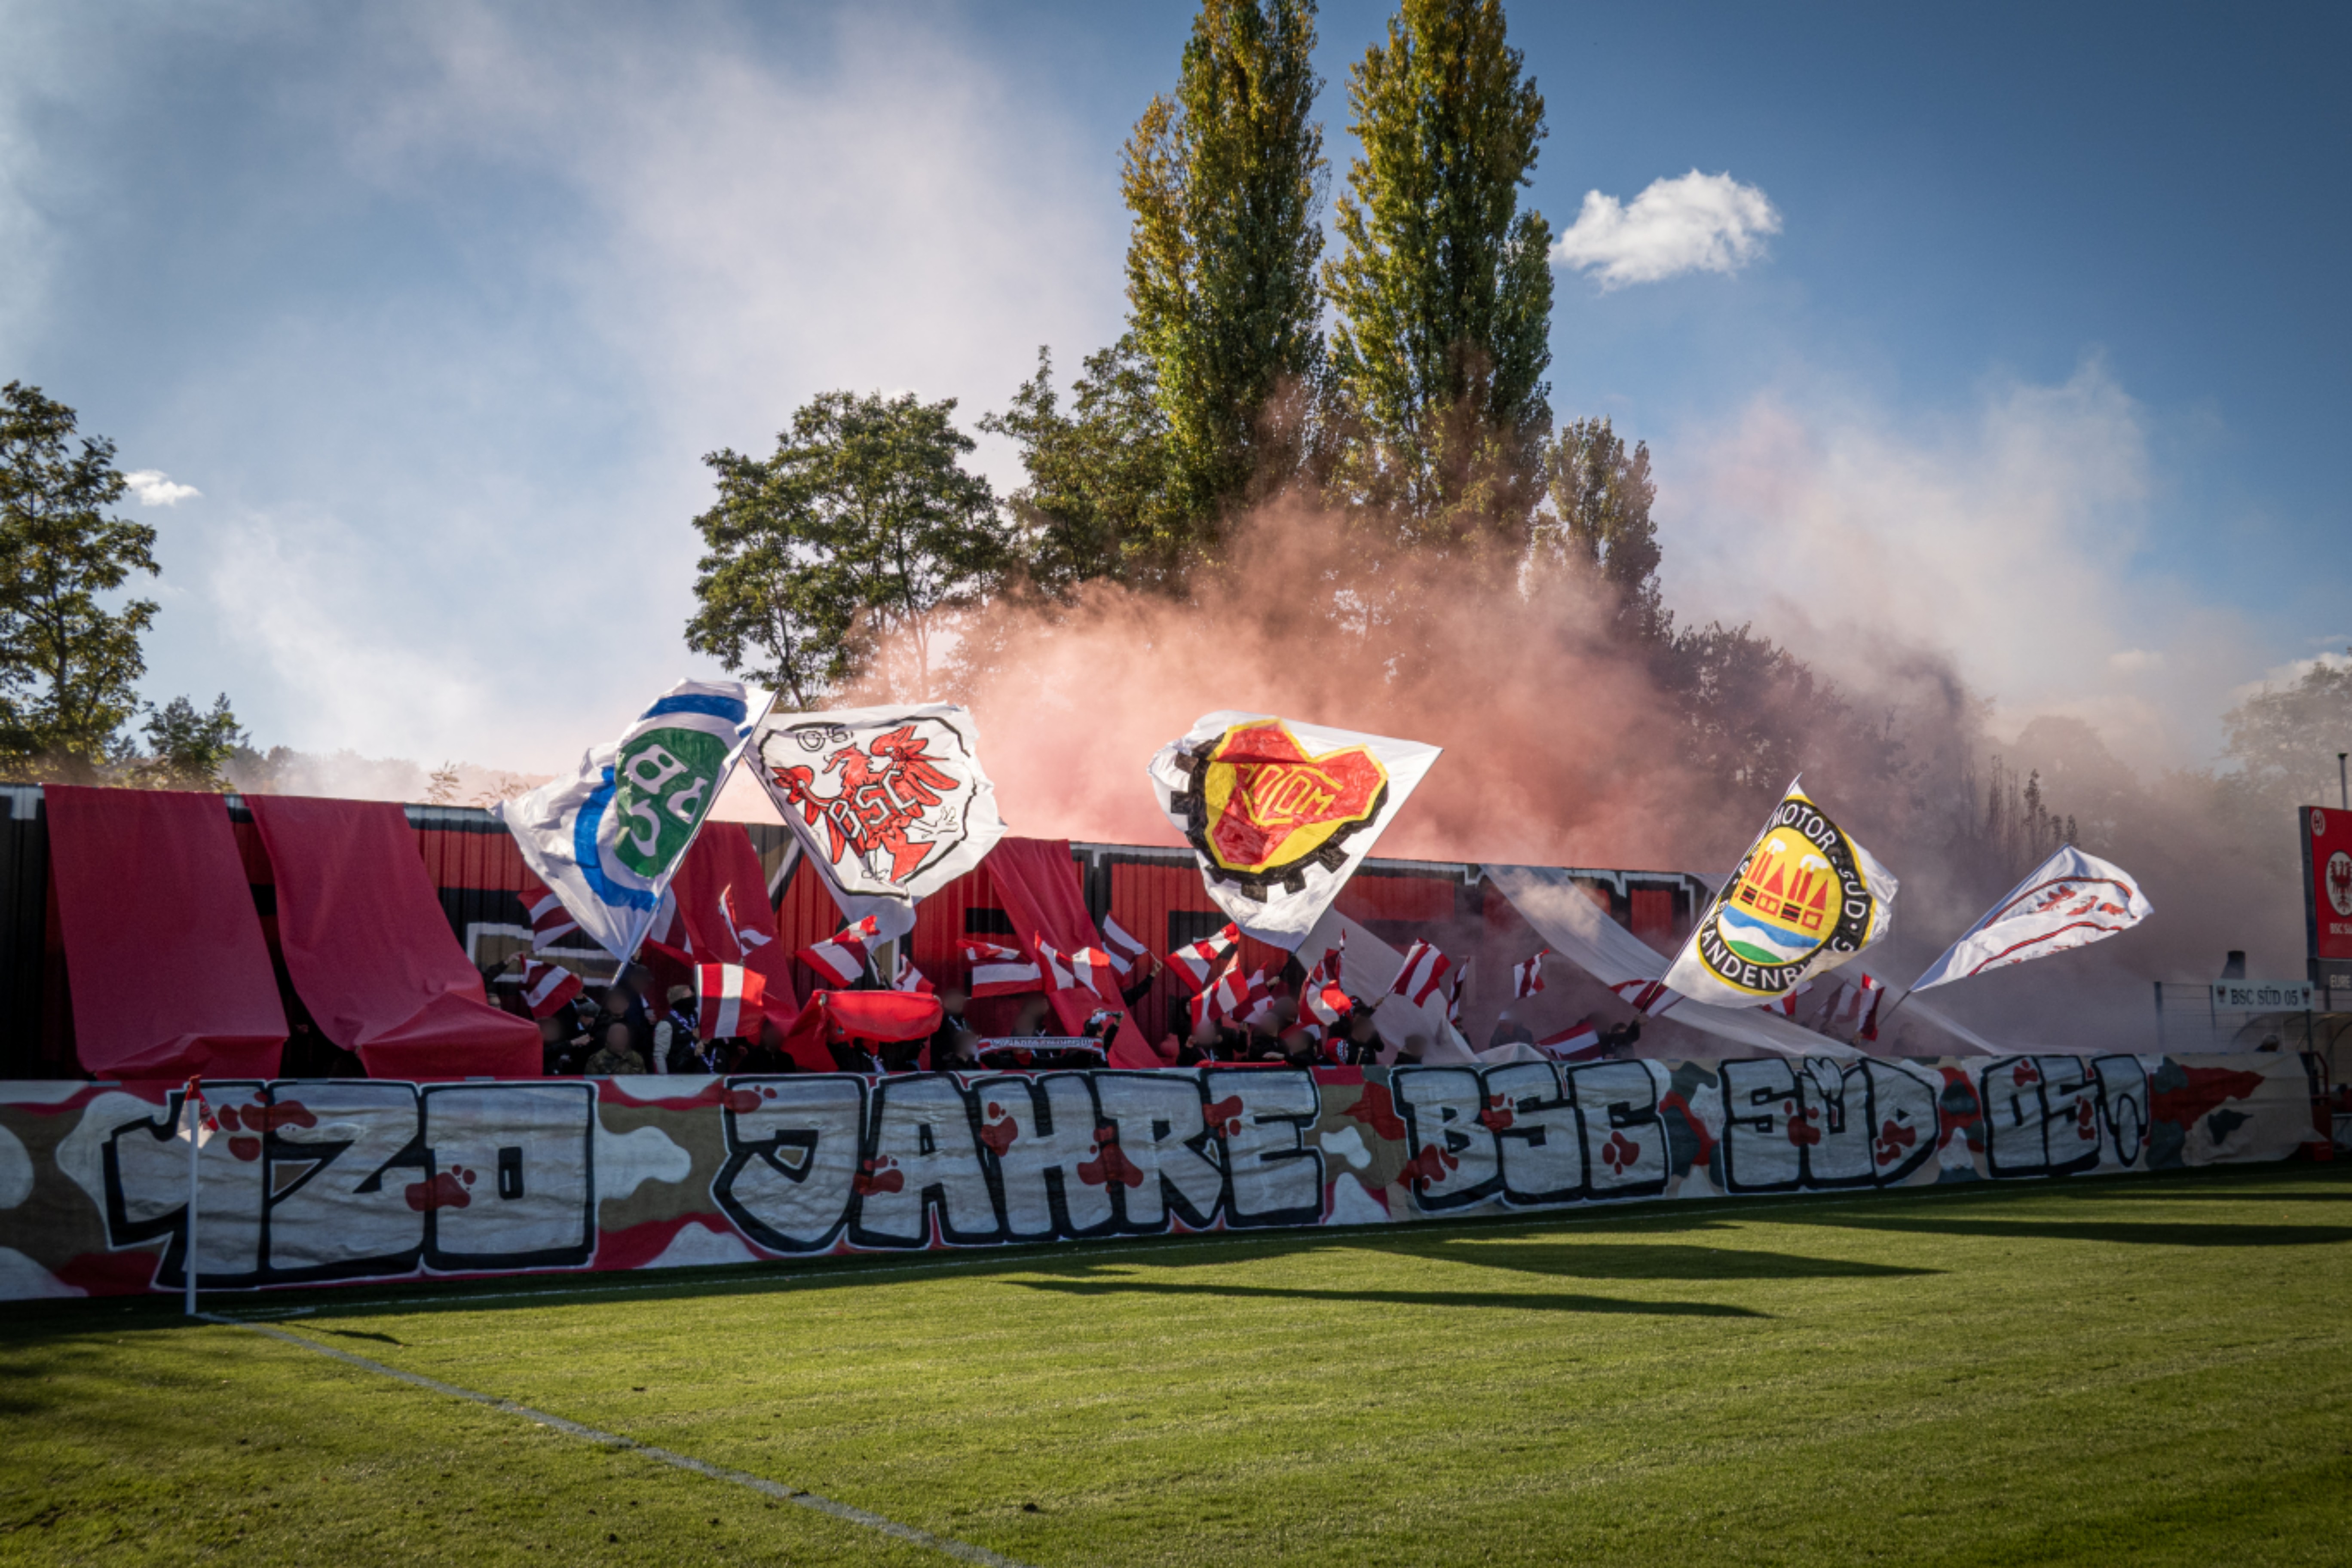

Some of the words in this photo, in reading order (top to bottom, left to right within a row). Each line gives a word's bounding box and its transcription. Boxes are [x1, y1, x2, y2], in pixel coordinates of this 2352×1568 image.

[828, 769, 917, 841] BSC
[2231, 989, 2254, 1004] BSC
[2257, 986, 2282, 1005] SÜD
[2285, 990, 2298, 1006] 05
[102, 1080, 597, 1288] 120
[710, 1068, 1326, 1253] JAHRE
[1391, 1059, 1670, 1212] BSC
